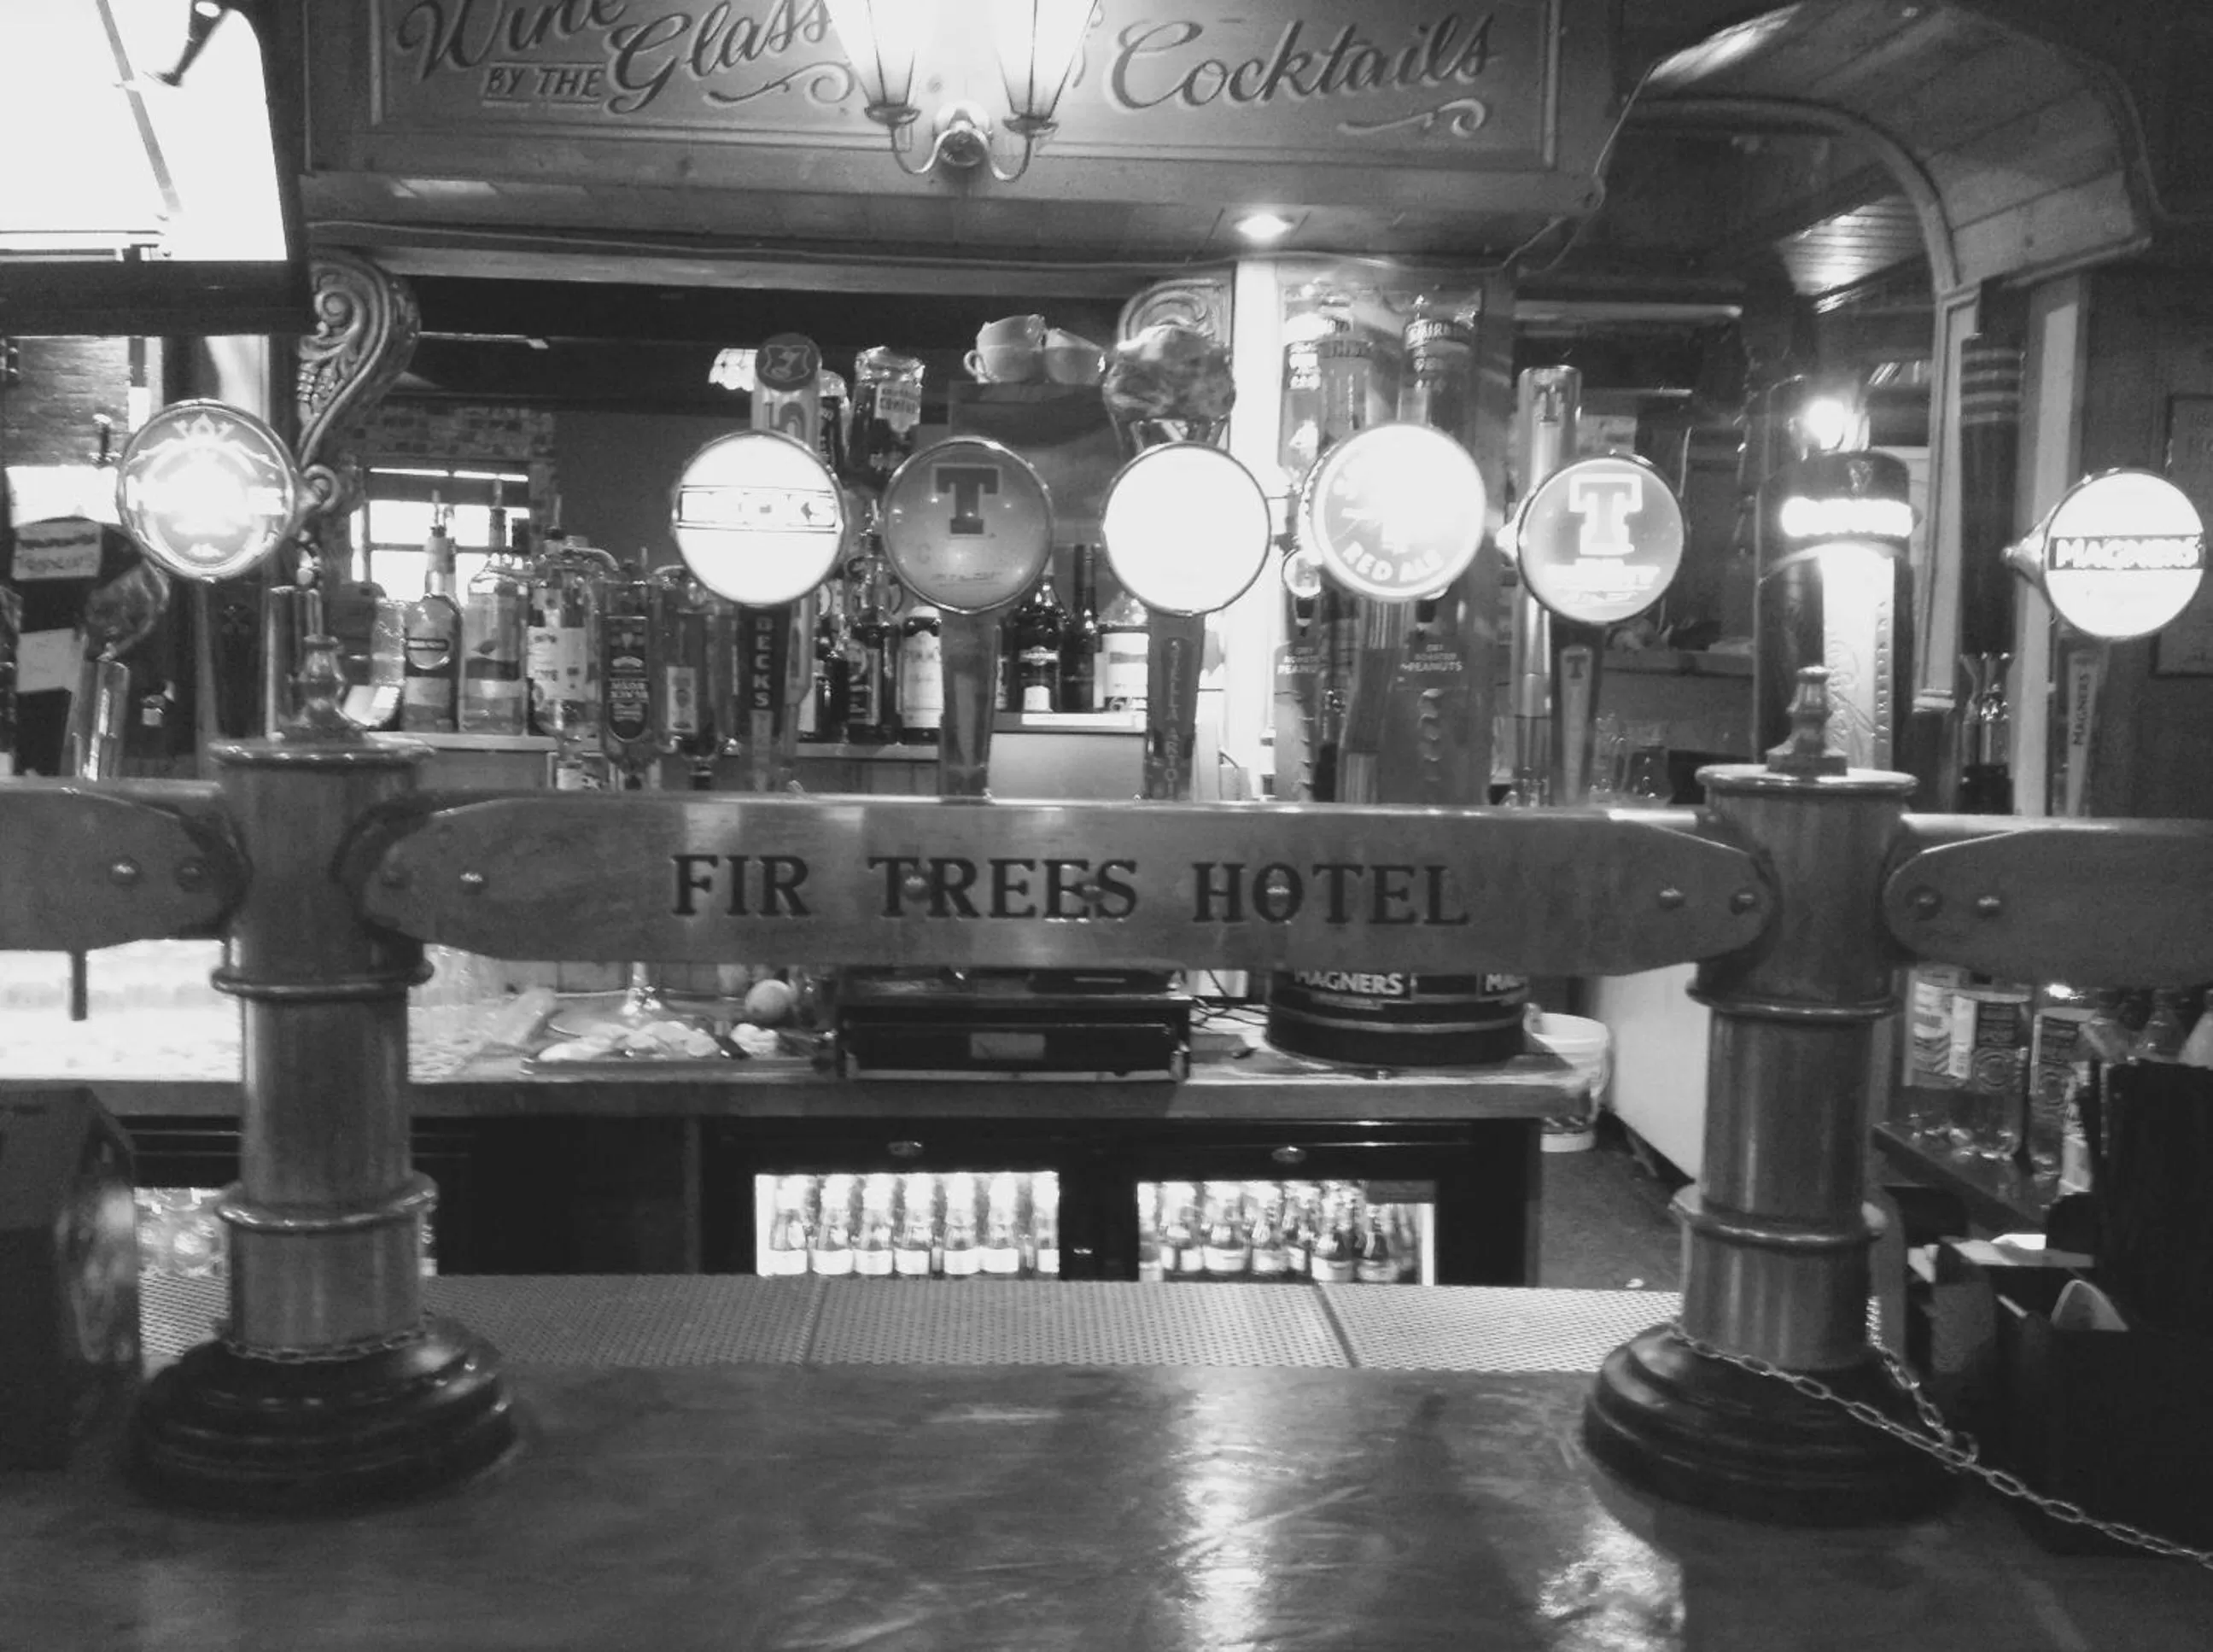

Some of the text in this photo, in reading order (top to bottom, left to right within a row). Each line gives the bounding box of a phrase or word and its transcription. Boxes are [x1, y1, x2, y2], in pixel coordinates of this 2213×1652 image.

[488, 67, 601, 97] BY THE
[606, 0, 833, 115] Glass
[1111, 12, 1496, 109] Cocktails
[933, 465, 1001, 537] T
[1569, 473, 1644, 555] T
[1342, 540, 1394, 581] RED
[1164, 727, 1181, 799] ARTOI
[672, 855, 1470, 925] FIR TREES HOTEL
